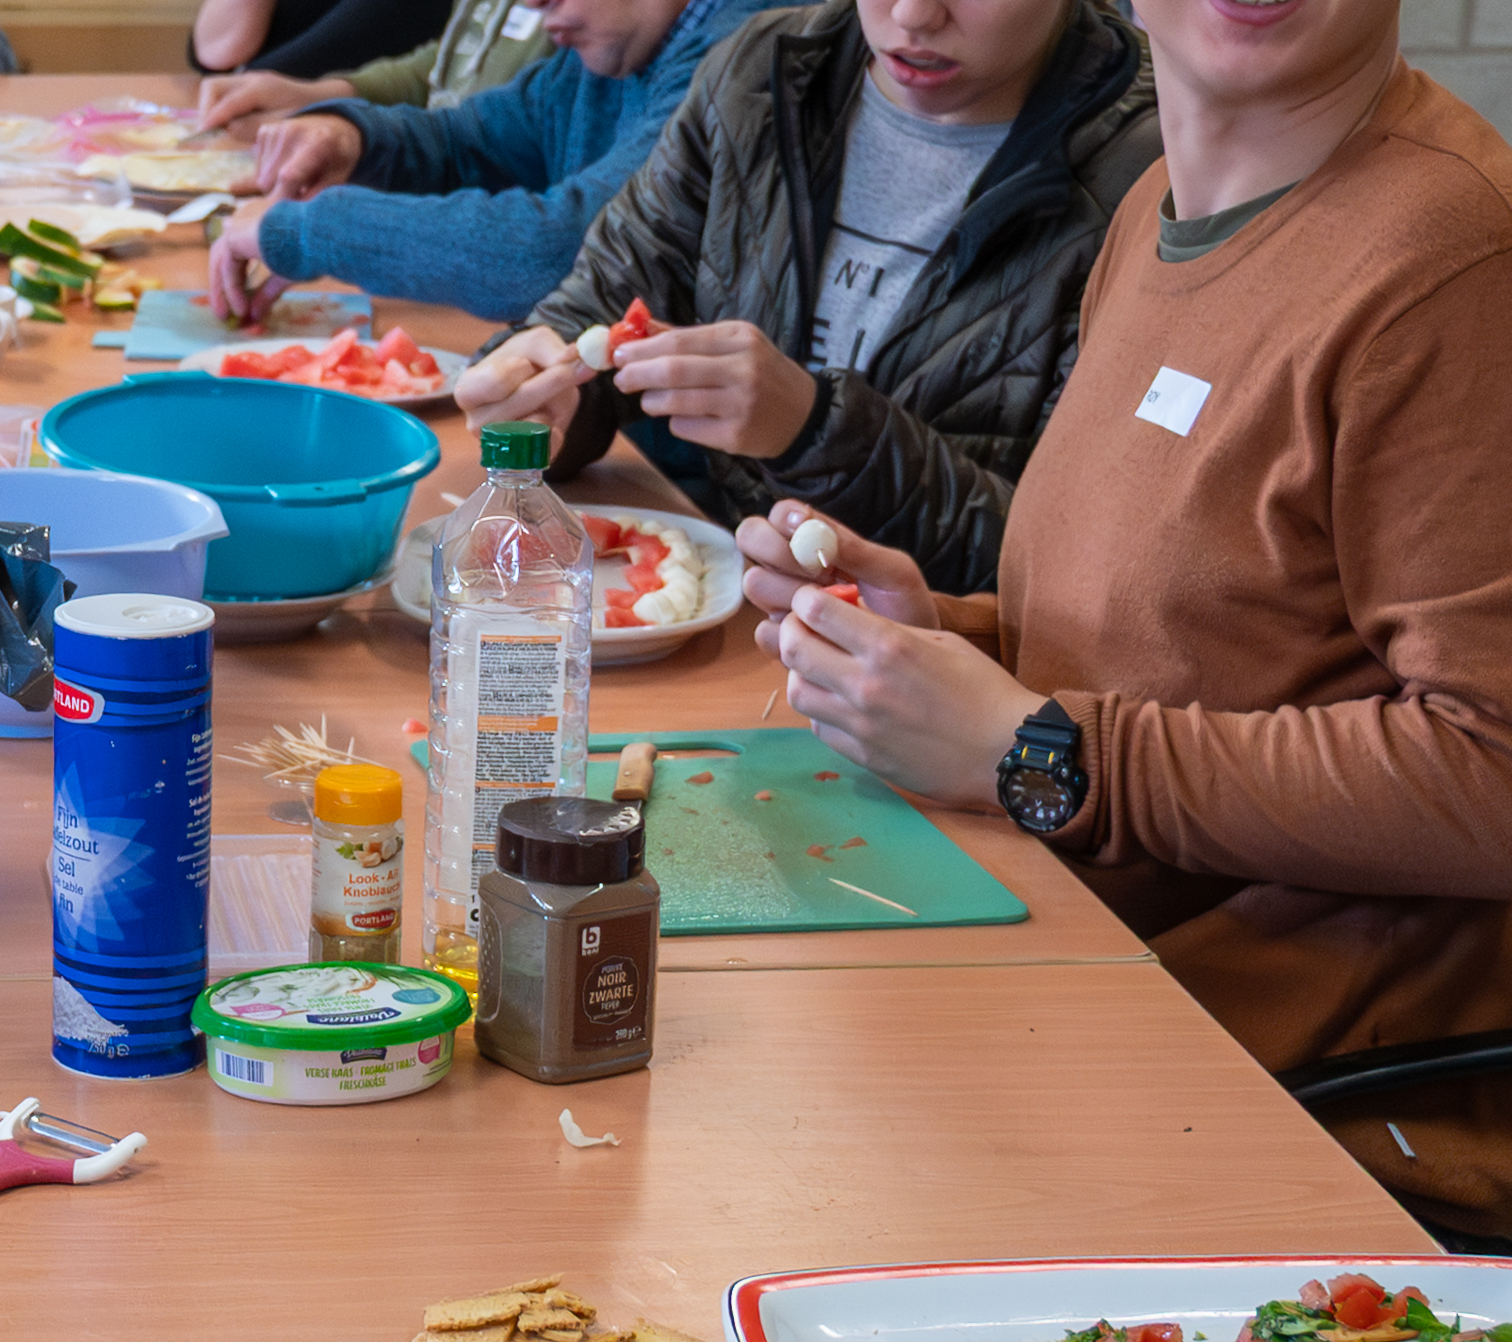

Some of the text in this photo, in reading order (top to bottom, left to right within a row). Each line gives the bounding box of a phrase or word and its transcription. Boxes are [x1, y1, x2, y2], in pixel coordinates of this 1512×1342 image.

[54, 689, 90, 713] TLAND
[57, 805, 78, 829] Fijn
[58, 856, 75, 877] Sel
[62, 878, 84, 895] table
[349, 873, 379, 884] Look
[58, 892, 74, 914] fin
[354, 913, 395, 925] PORTLAND
[598, 972, 627, 987] NOIR
[589, 984, 634, 1004] ZWARTE
